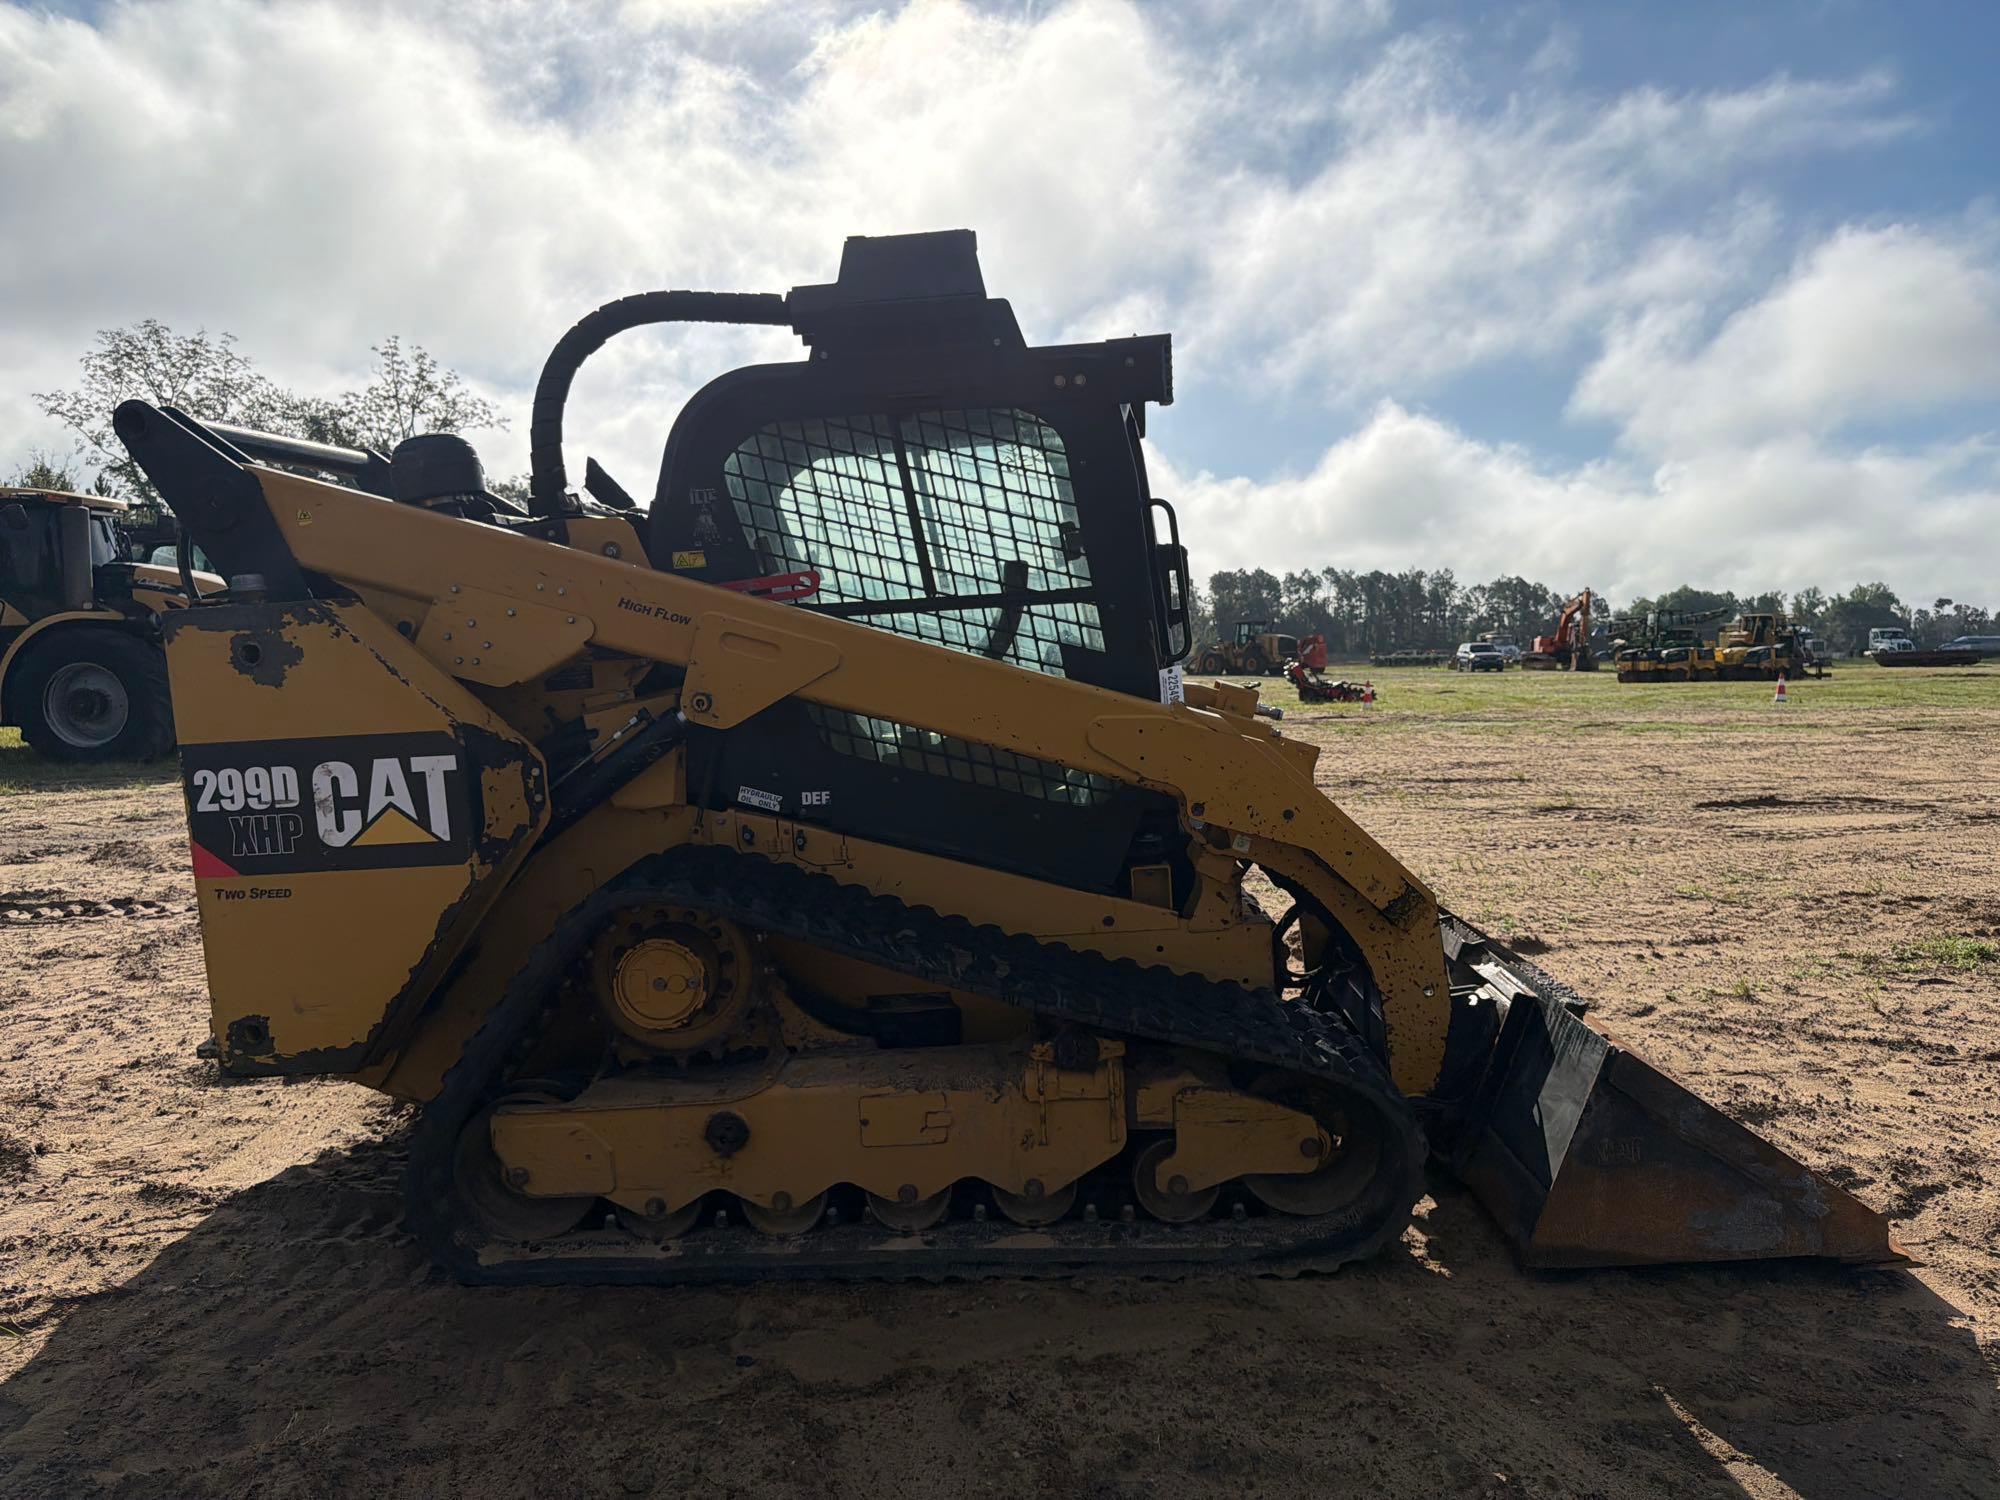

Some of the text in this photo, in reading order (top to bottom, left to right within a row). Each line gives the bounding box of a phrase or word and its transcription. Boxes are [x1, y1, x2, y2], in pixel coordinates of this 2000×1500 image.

[193, 755, 457, 847] 299D CAT
[740, 787, 782, 804] HYDRAULIC
[741, 794, 777, 809] OIL ONLY
[801, 791, 831, 805] DEF
[229, 813, 304, 856] XHP
